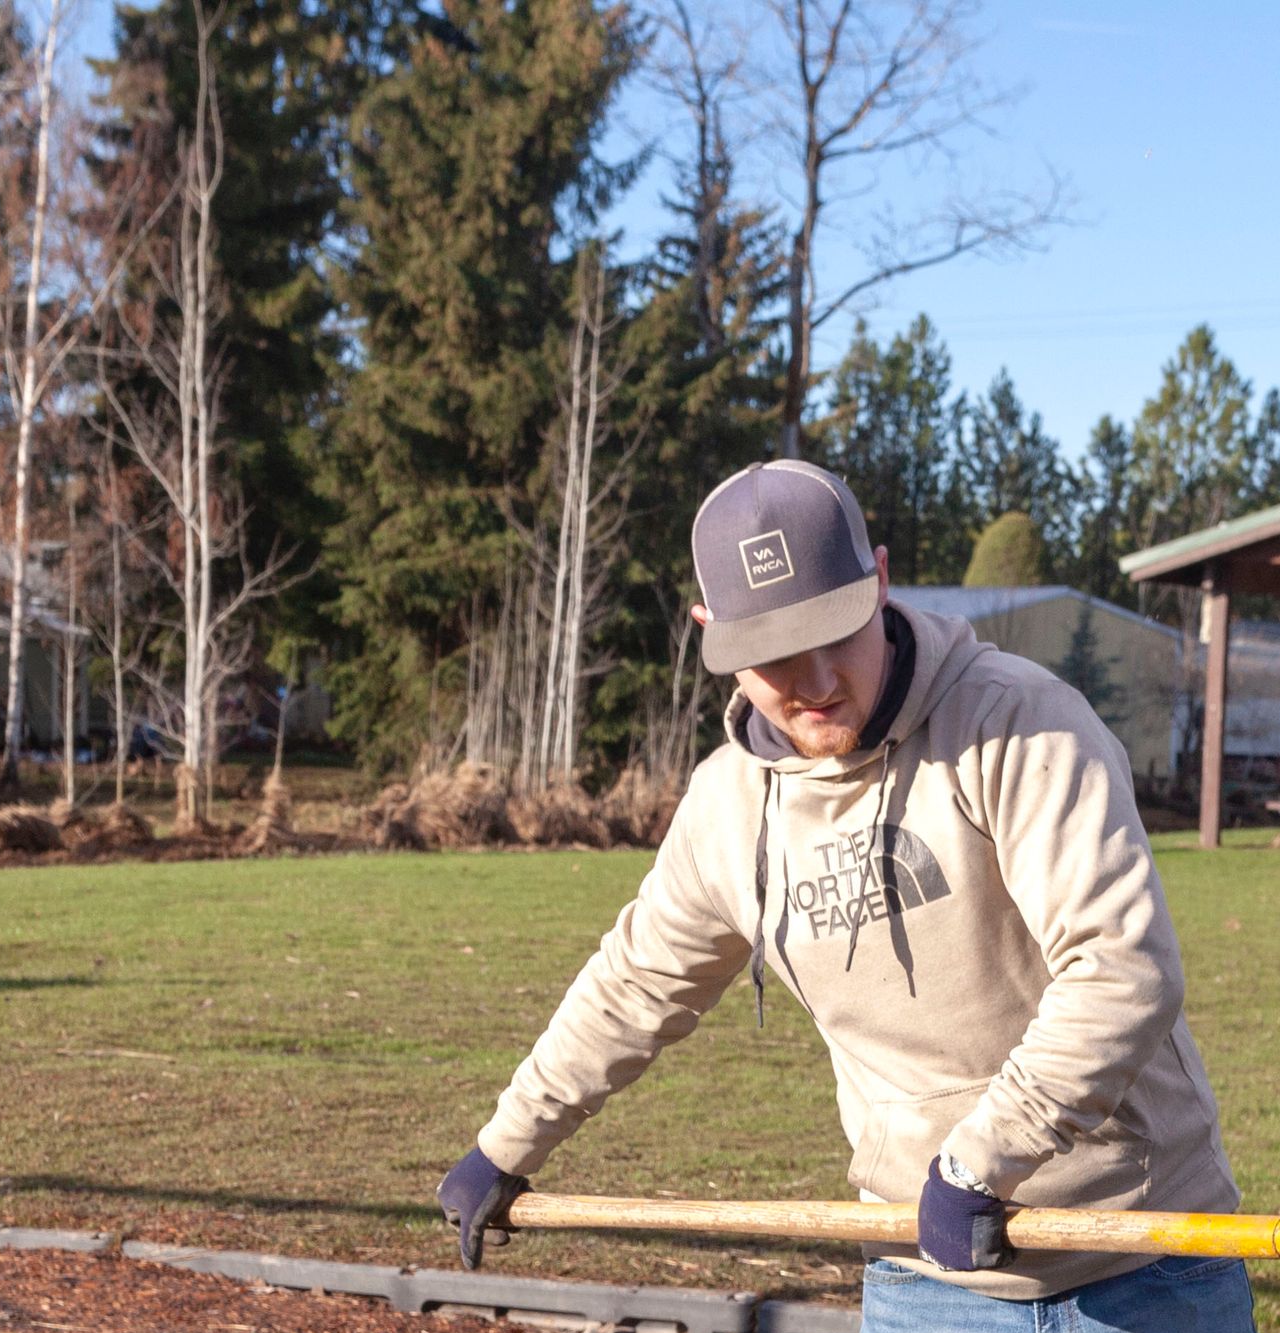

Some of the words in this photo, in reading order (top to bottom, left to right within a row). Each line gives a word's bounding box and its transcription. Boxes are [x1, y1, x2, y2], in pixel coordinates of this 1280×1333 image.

[752, 559, 785, 575] RVCA
[753, 547, 774, 561] VA
[814, 830, 869, 873] THE
[788, 864, 879, 914] NORTH
[809, 890, 888, 940] FACE
